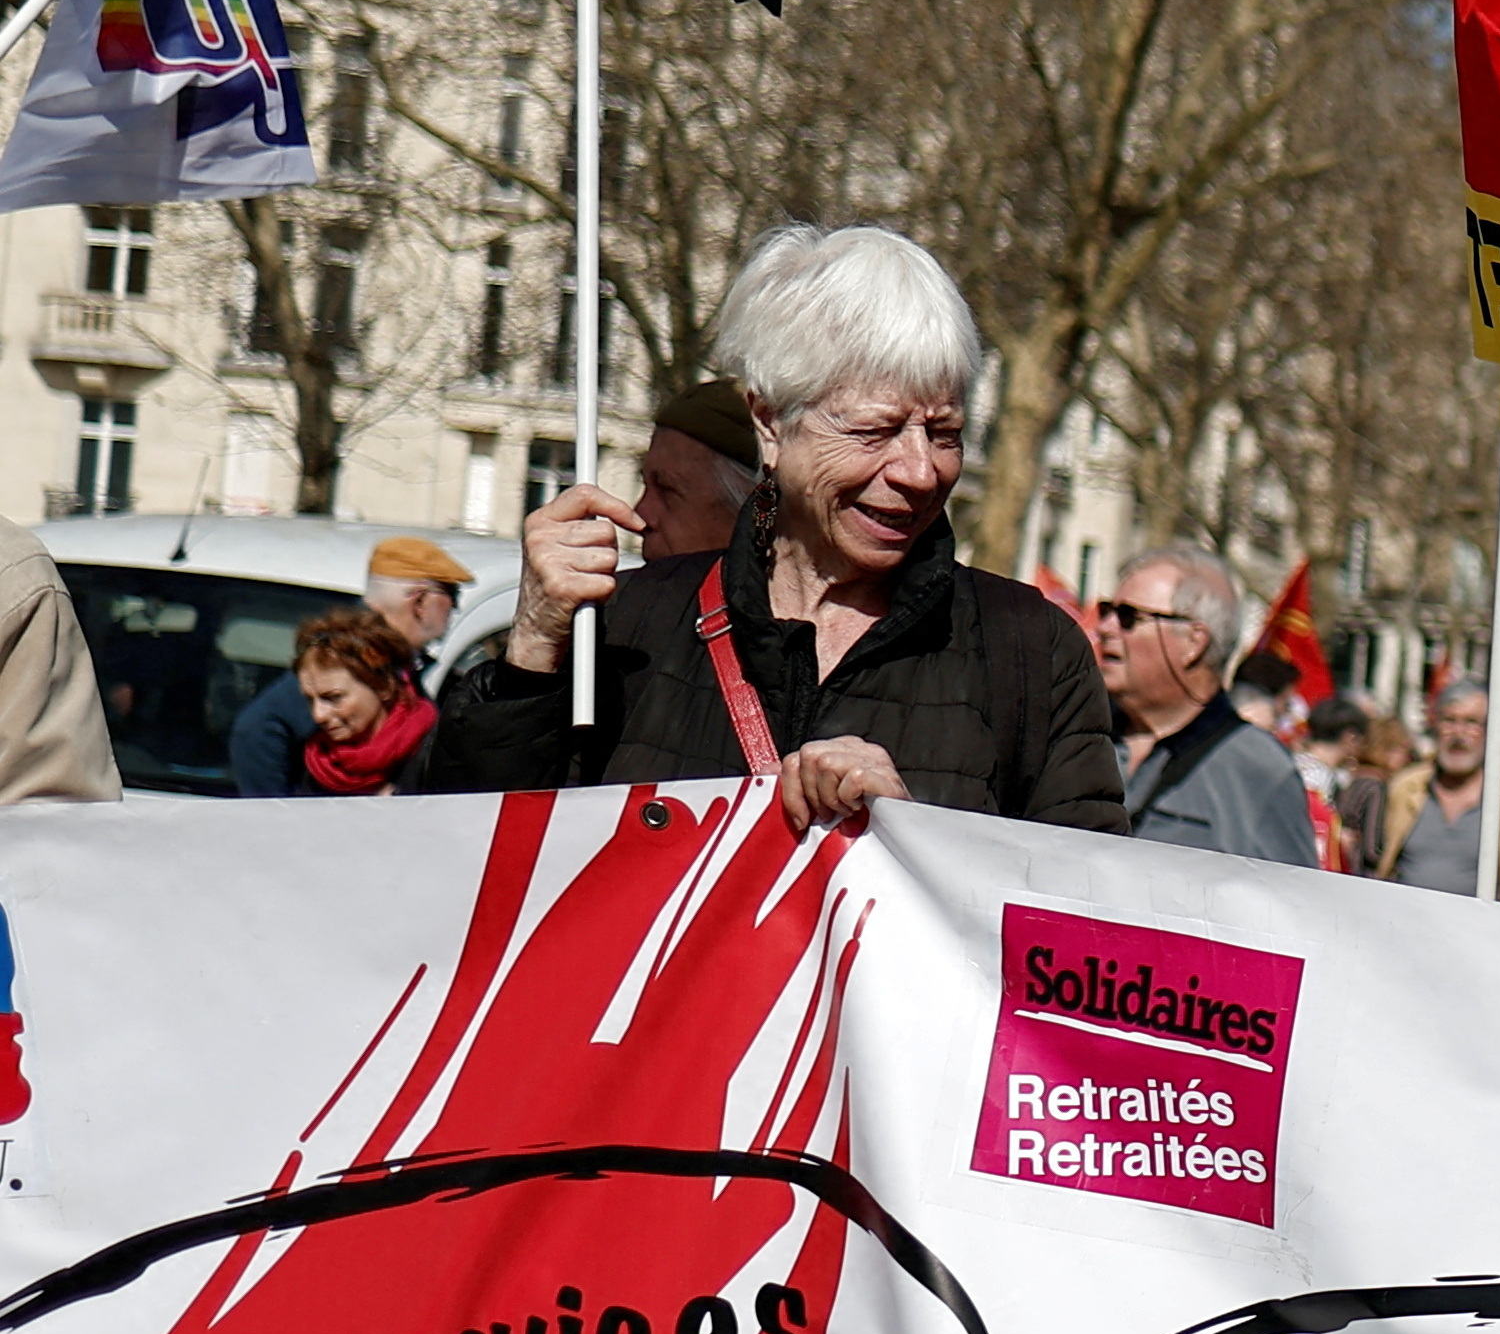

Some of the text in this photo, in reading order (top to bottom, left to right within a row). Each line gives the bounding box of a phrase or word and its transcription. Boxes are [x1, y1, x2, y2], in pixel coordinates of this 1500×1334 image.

[1025, 945, 1277, 1055] Solidaires
[1008, 1074, 1234, 1127] Retraités
[1008, 1130, 1267, 1184] Retraitées
